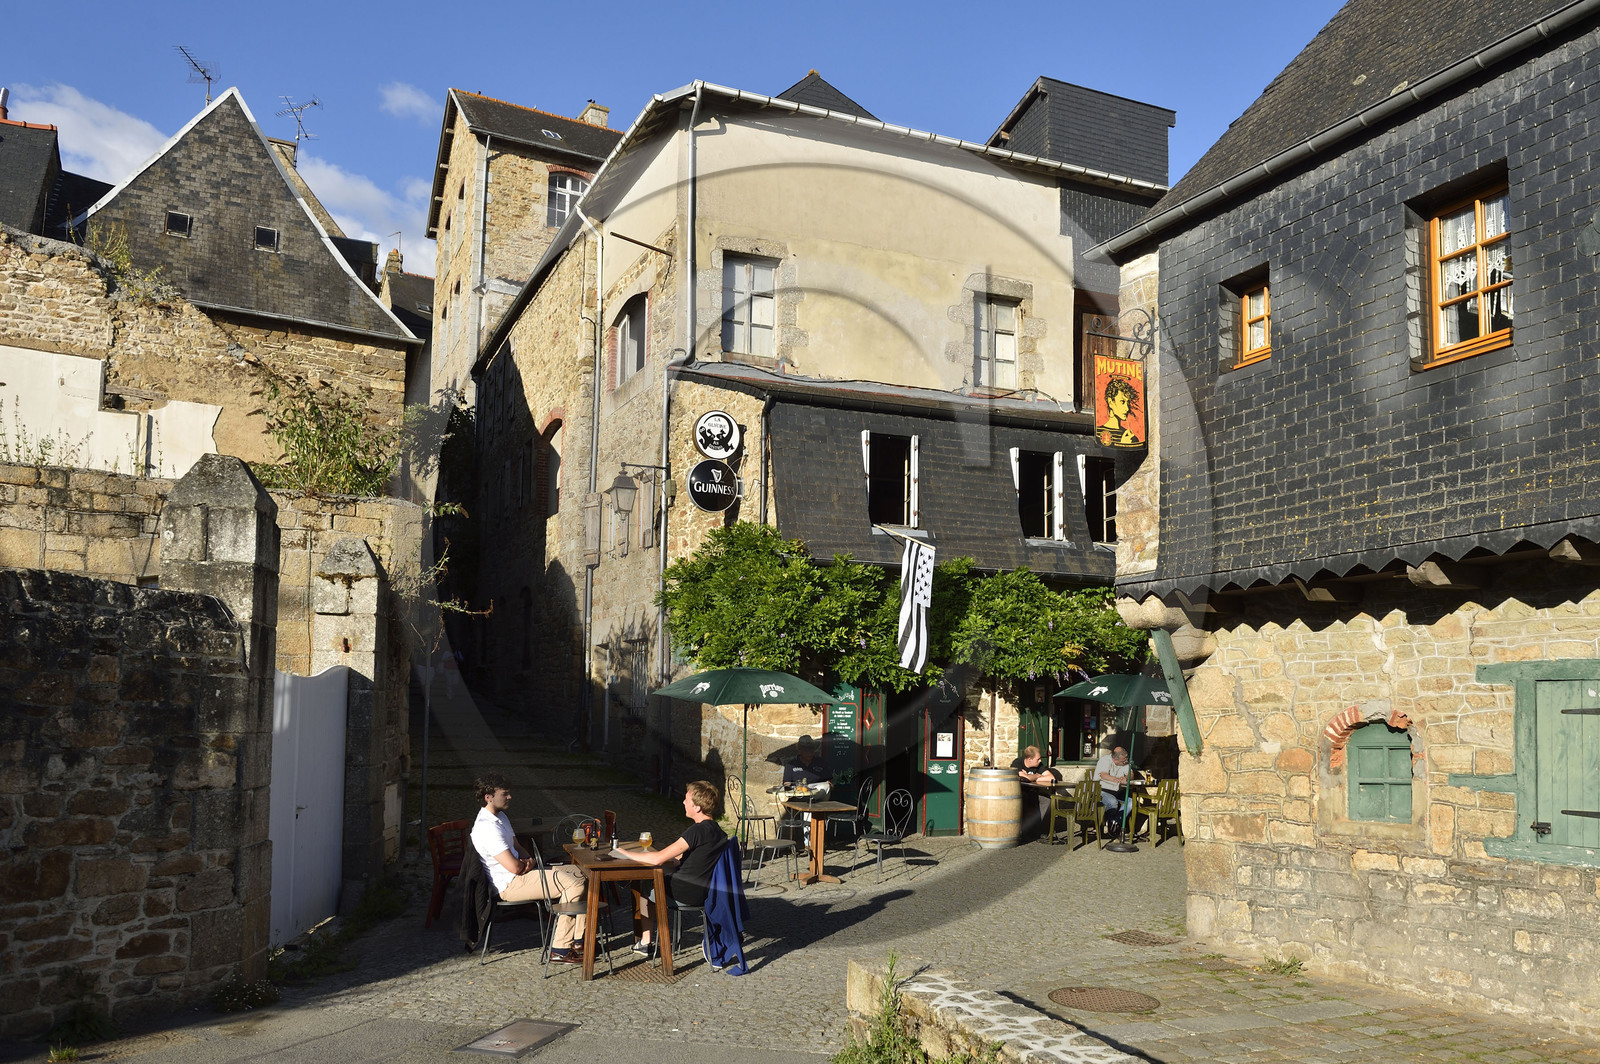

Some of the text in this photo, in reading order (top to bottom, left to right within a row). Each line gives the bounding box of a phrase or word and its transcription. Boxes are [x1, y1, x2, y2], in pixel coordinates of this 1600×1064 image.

[1096, 357, 1142, 381] MUTINE
[694, 482, 734, 496] GUINNESS
[1150, 691, 1172, 702] Perrie
